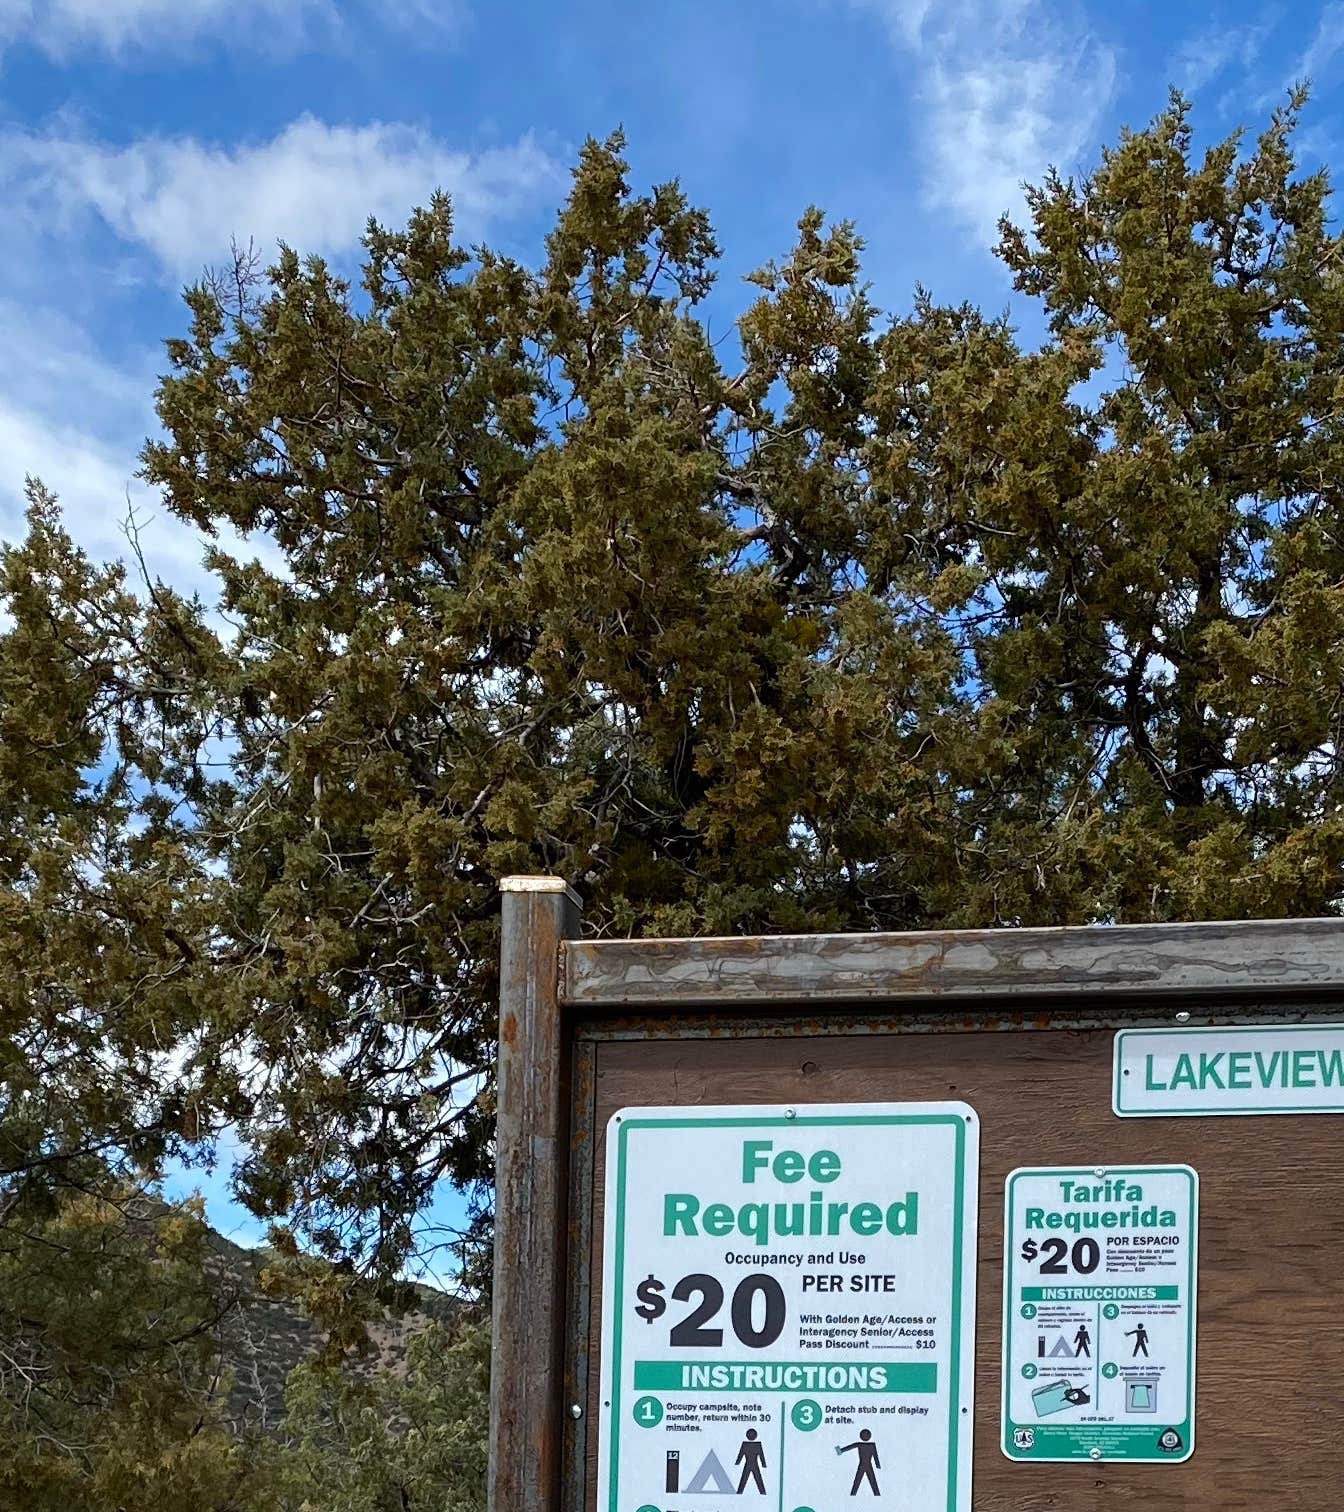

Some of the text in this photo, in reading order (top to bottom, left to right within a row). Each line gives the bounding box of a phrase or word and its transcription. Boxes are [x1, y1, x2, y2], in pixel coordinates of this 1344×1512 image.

[742, 1140, 842, 1184] Fee
[1060, 1179, 1142, 1203] Tarifa
[663, 1191, 918, 1246] Required
[1026, 1206, 1176, 1233] Requerida
[1107, 1235, 1179, 1246] POR ESPACIO
[725, 1252, 866, 1267] Occupancy and Use
[1021, 1237, 1100, 1275] $20
[802, 1275, 896, 1293] PER SITE
[1042, 1288, 1157, 1300] INSTRUCCIONES
[634, 1273, 786, 1349] $20
[1025, 1307, 1032, 1315] 1
[1107, 1307, 1115, 1316] 3
[800, 1314, 936, 1325] With Golden Age/Access or
[799, 1327, 934, 1338] Interagency Senior/Access
[799, 1340, 936, 1350] Pass Discount $10
[1026, 1366, 1033, 1376] 2
[1106, 1366, 1114, 1375] 4
[681, 1365, 888, 1389] INSTRUCTIONS
[641, 1401, 656, 1420] 1
[666, 1402, 762, 1412] Occupy campsite, note
[825, 1405, 929, 1416] Detach stub and display
[666, 1413, 771, 1422] number, return within 30
[799, 1405, 814, 1424] 3
[824, 1416, 854, 1424] at site.
[666, 1424, 702, 1432] minutes.
